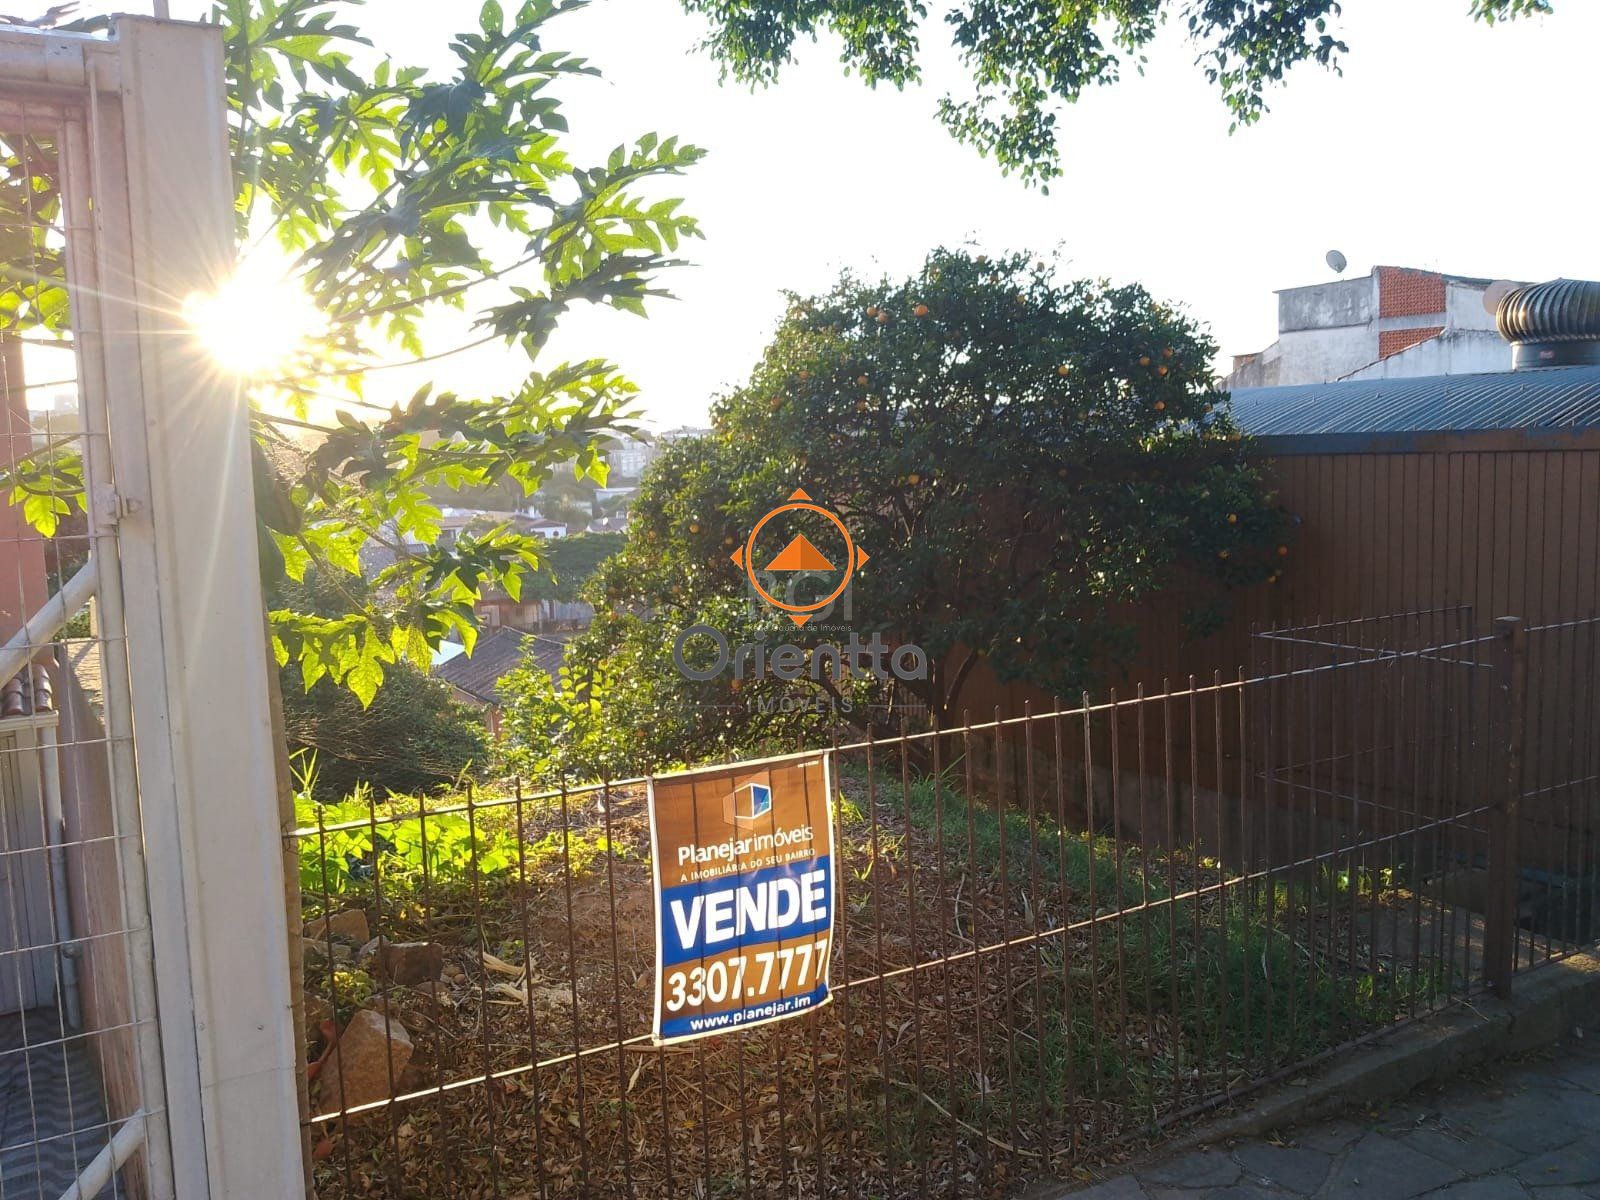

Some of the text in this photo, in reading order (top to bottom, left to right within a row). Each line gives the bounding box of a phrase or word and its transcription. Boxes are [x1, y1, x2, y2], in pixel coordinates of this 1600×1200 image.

[680, 873, 688, 883] A
[750, 858, 763, 869] DO
[765, 854, 783, 866] SEU
[785, 848, 816, 862] BAIRRO
[670, 869, 827, 950] VENDE
[666, 938, 828, 1012] 3307.7777
[690, 995, 811, 1031] www.planejar.im
